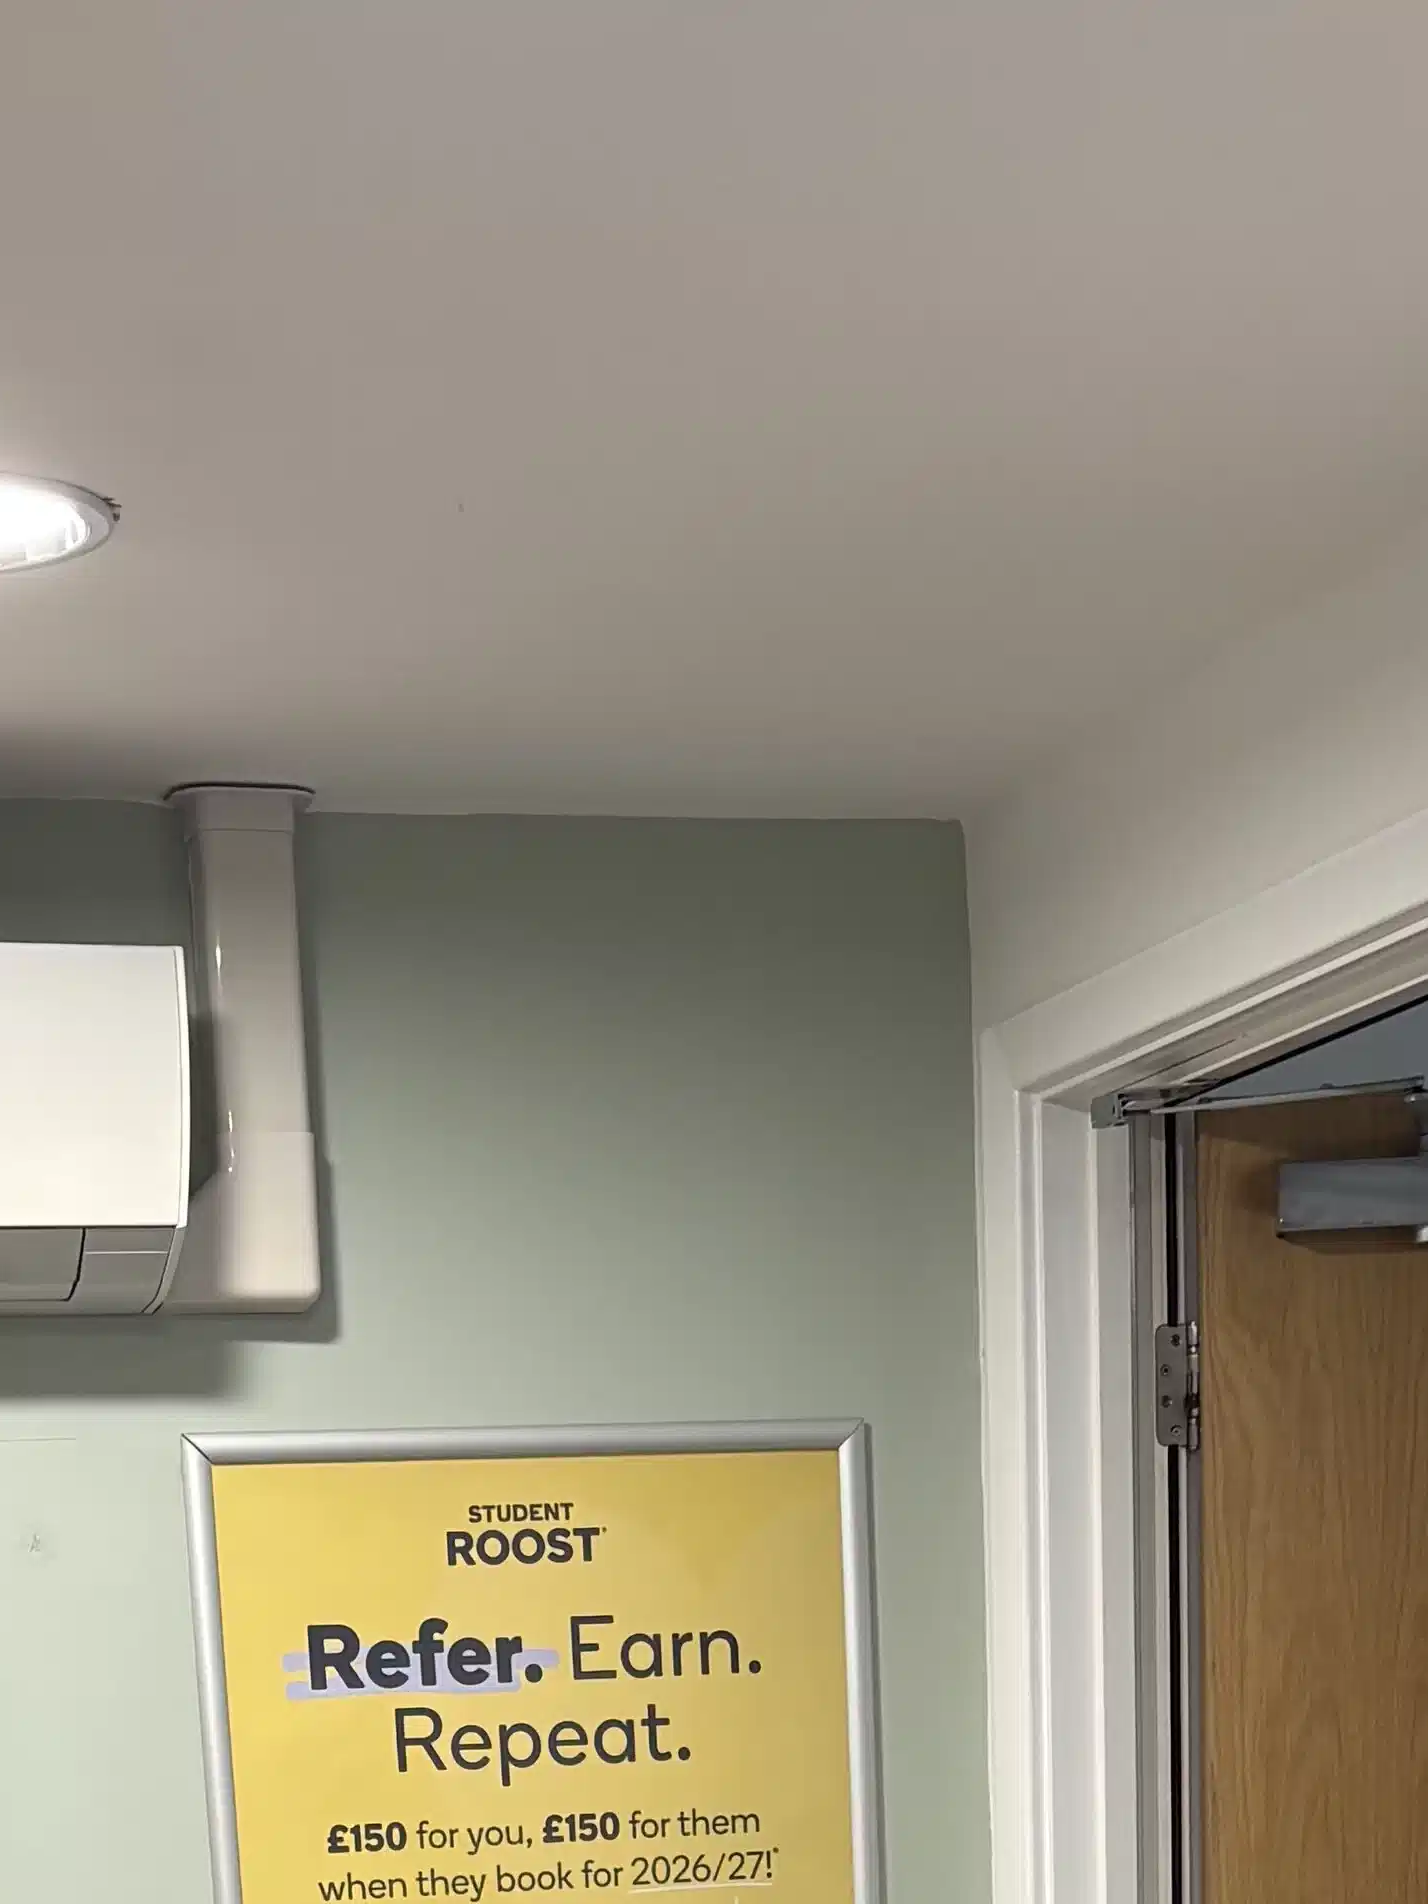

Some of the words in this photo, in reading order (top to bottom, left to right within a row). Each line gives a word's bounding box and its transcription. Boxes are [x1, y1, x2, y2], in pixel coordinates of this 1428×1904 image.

[468, 1502, 574, 1524] STUDENT
[307, 1617, 544, 1692] Refer.
[569, 1614, 763, 1682] Earn.
[394, 1703, 692, 1788] Repeat.
[326, 1822, 408, 1854] £150
[416, 1820, 460, 1850] for
[466, 1824, 533, 1856] you,
[541, 1811, 621, 1845] £150
[629, 1810, 672, 1840] for
[677, 1807, 761, 1838] them
[317, 1871, 409, 1903] when
[416, 1867, 487, 1903] they
[496, 1861, 574, 1894] book
[581, 1859, 624, 1889] for
